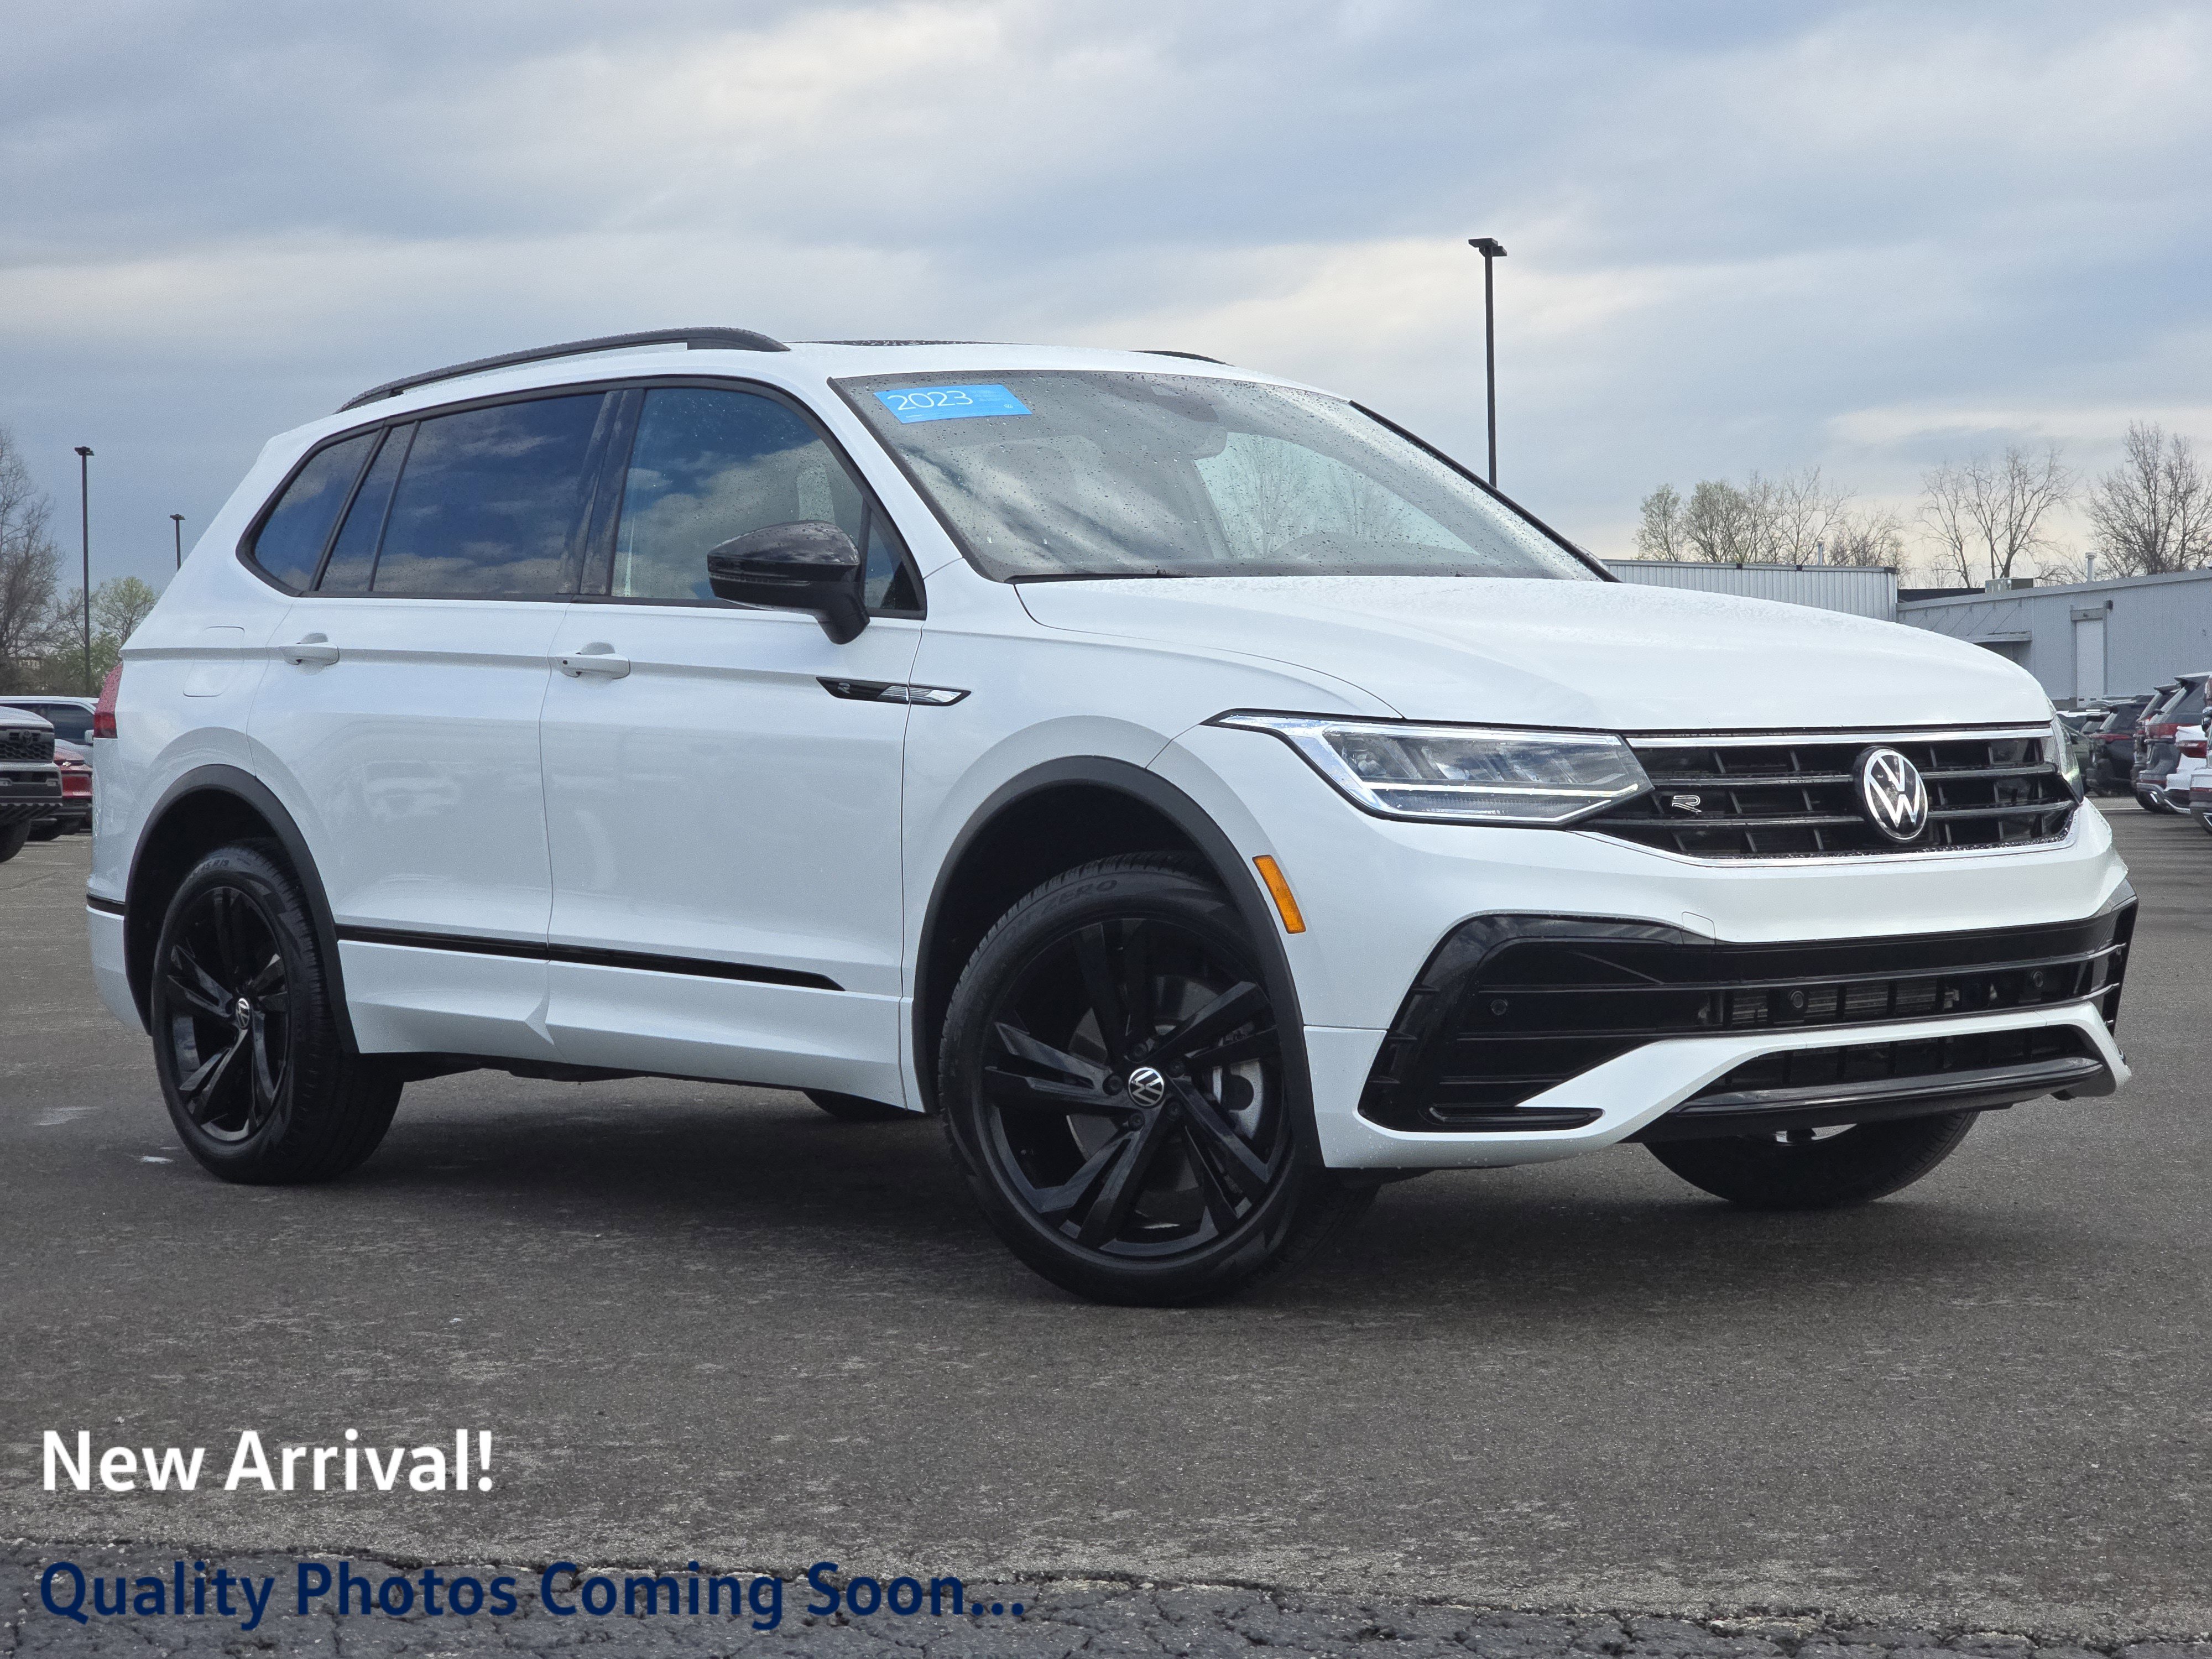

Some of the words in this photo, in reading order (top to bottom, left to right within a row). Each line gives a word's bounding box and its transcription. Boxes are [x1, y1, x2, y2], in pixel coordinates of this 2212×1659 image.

[887, 390, 973, 410] 2023
[1672, 795, 1702, 814] R
[1042, 879, 1118, 915] ZERO
